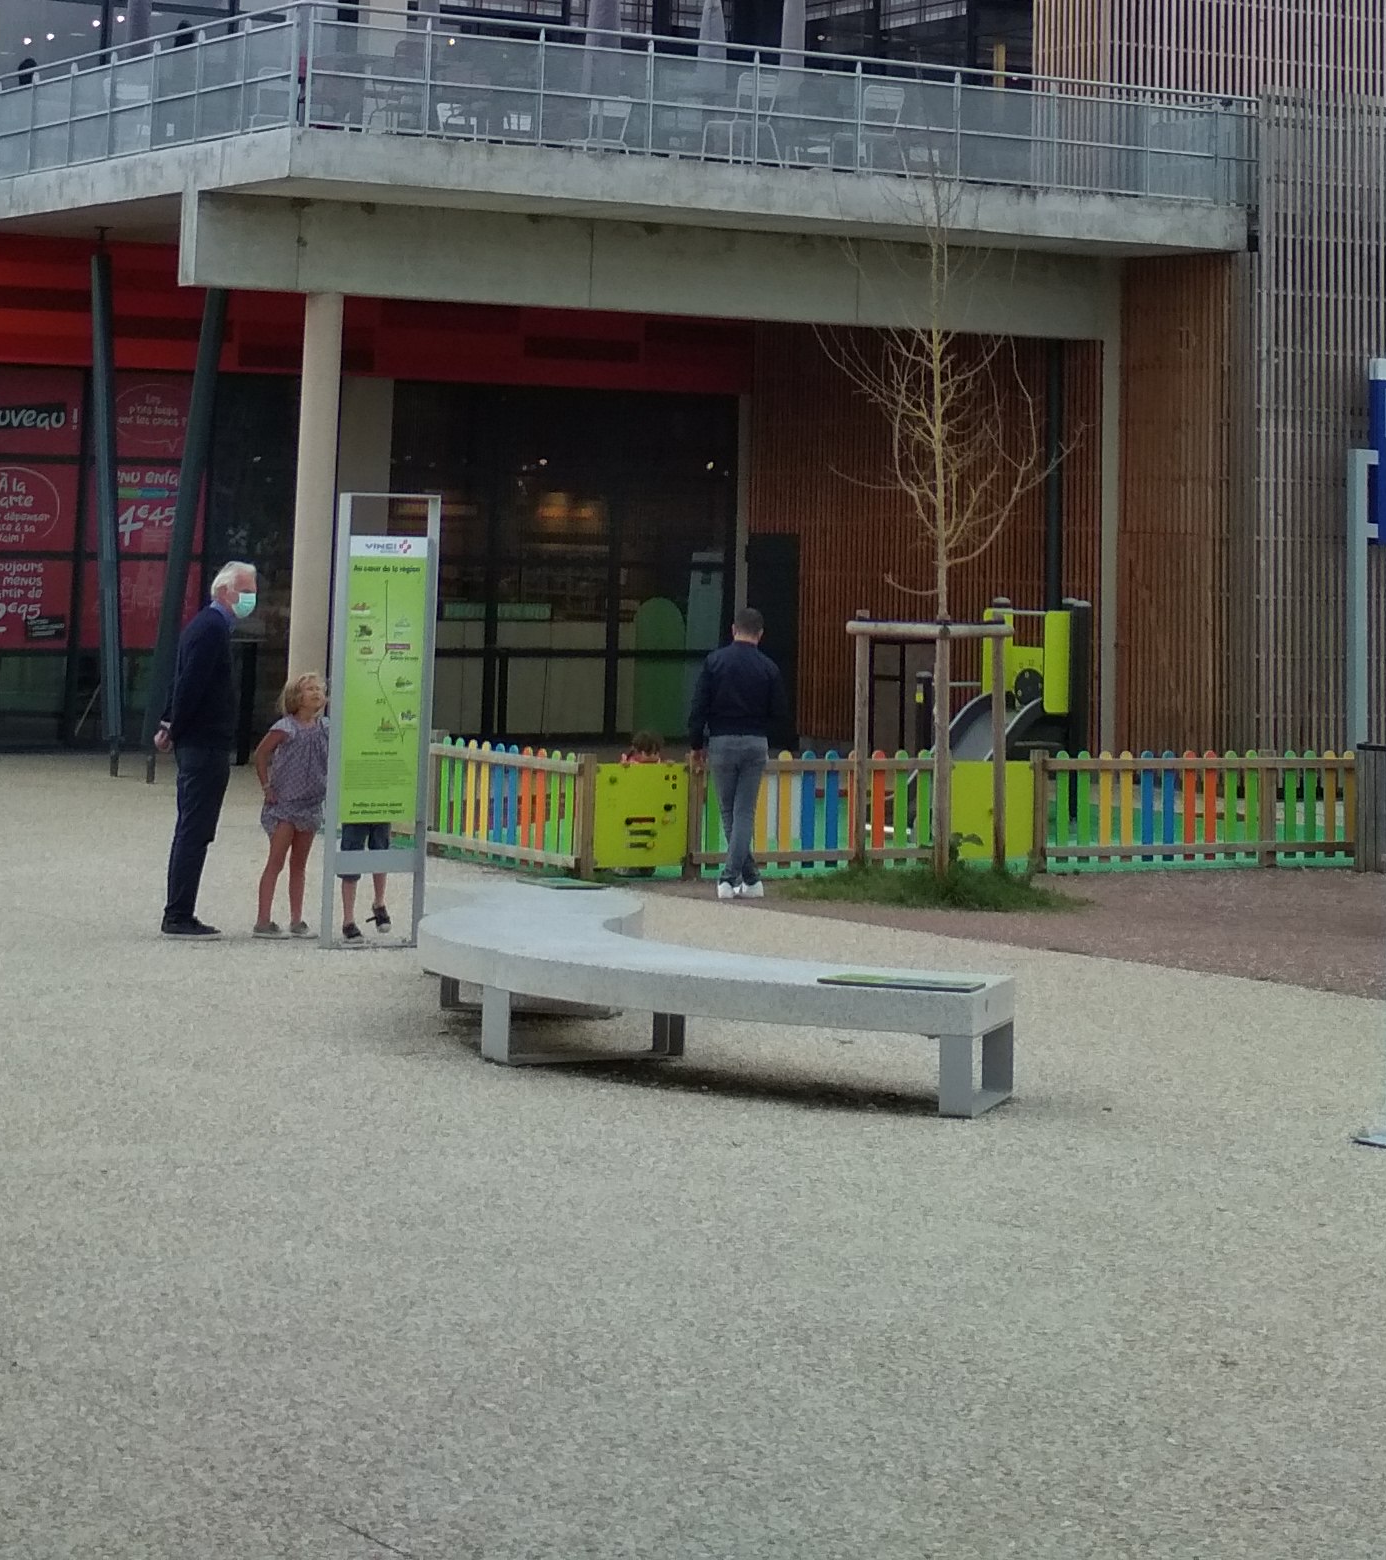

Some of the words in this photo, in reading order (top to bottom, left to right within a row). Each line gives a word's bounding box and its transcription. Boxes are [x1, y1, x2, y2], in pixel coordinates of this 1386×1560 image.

[72, 408, 79, 430] !
[12, 477, 27, 494] la
[27, 588, 43, 599] de
